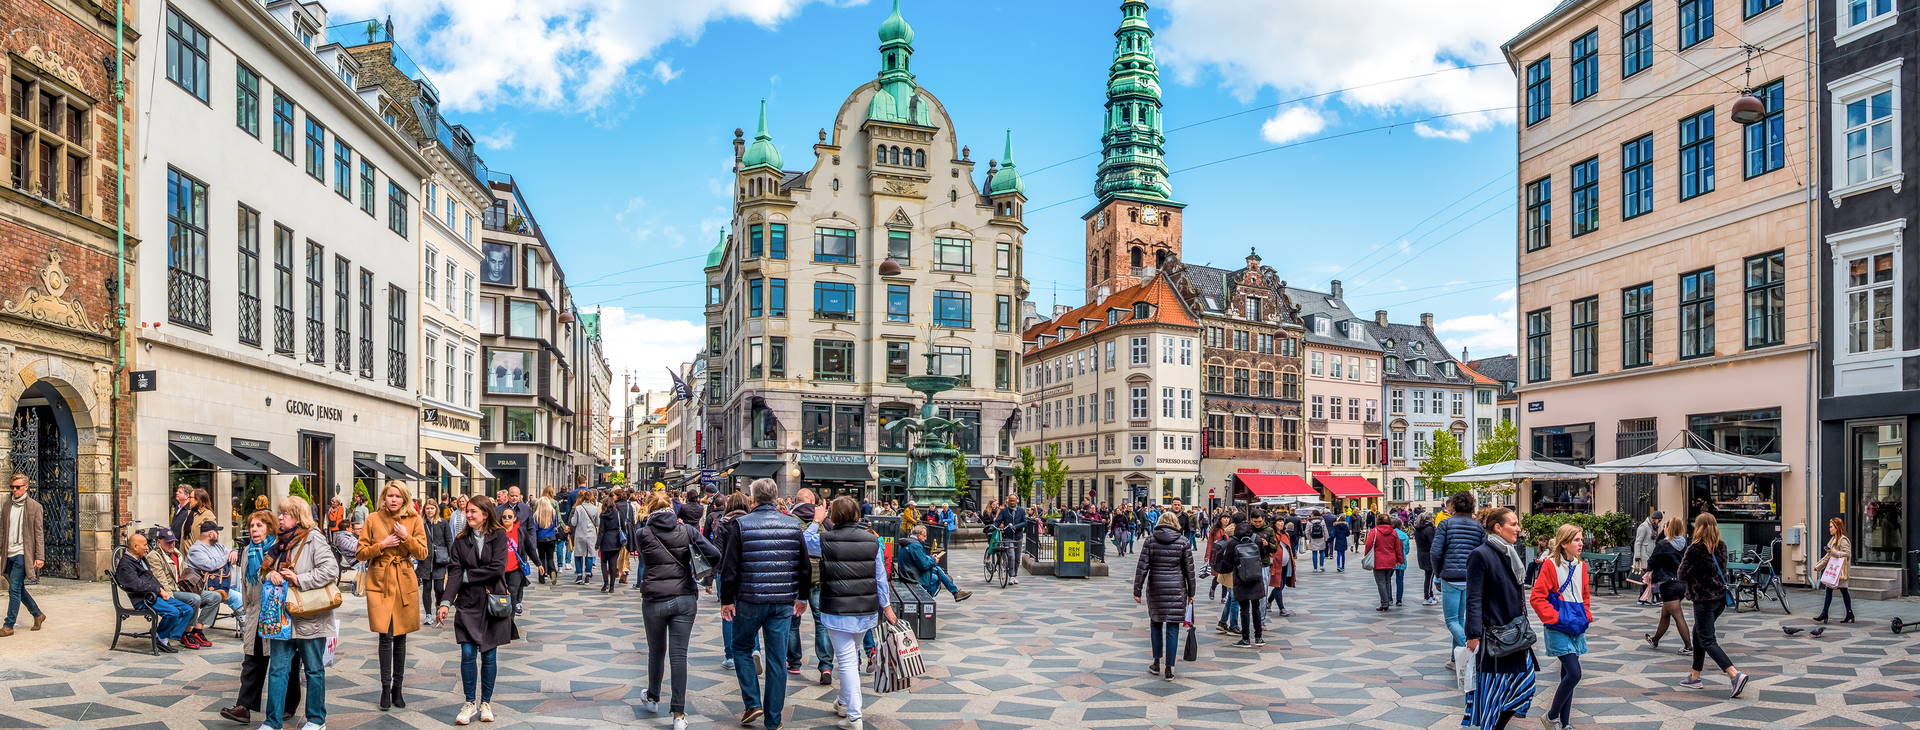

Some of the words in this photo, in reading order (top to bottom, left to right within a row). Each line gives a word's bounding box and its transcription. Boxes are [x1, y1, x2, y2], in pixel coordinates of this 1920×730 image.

[674, 381, 687, 400] HAY
[286, 399, 314, 417] GEORG
[316, 404, 343, 421] JENSEN
[432, 415, 448, 428] OUIS
